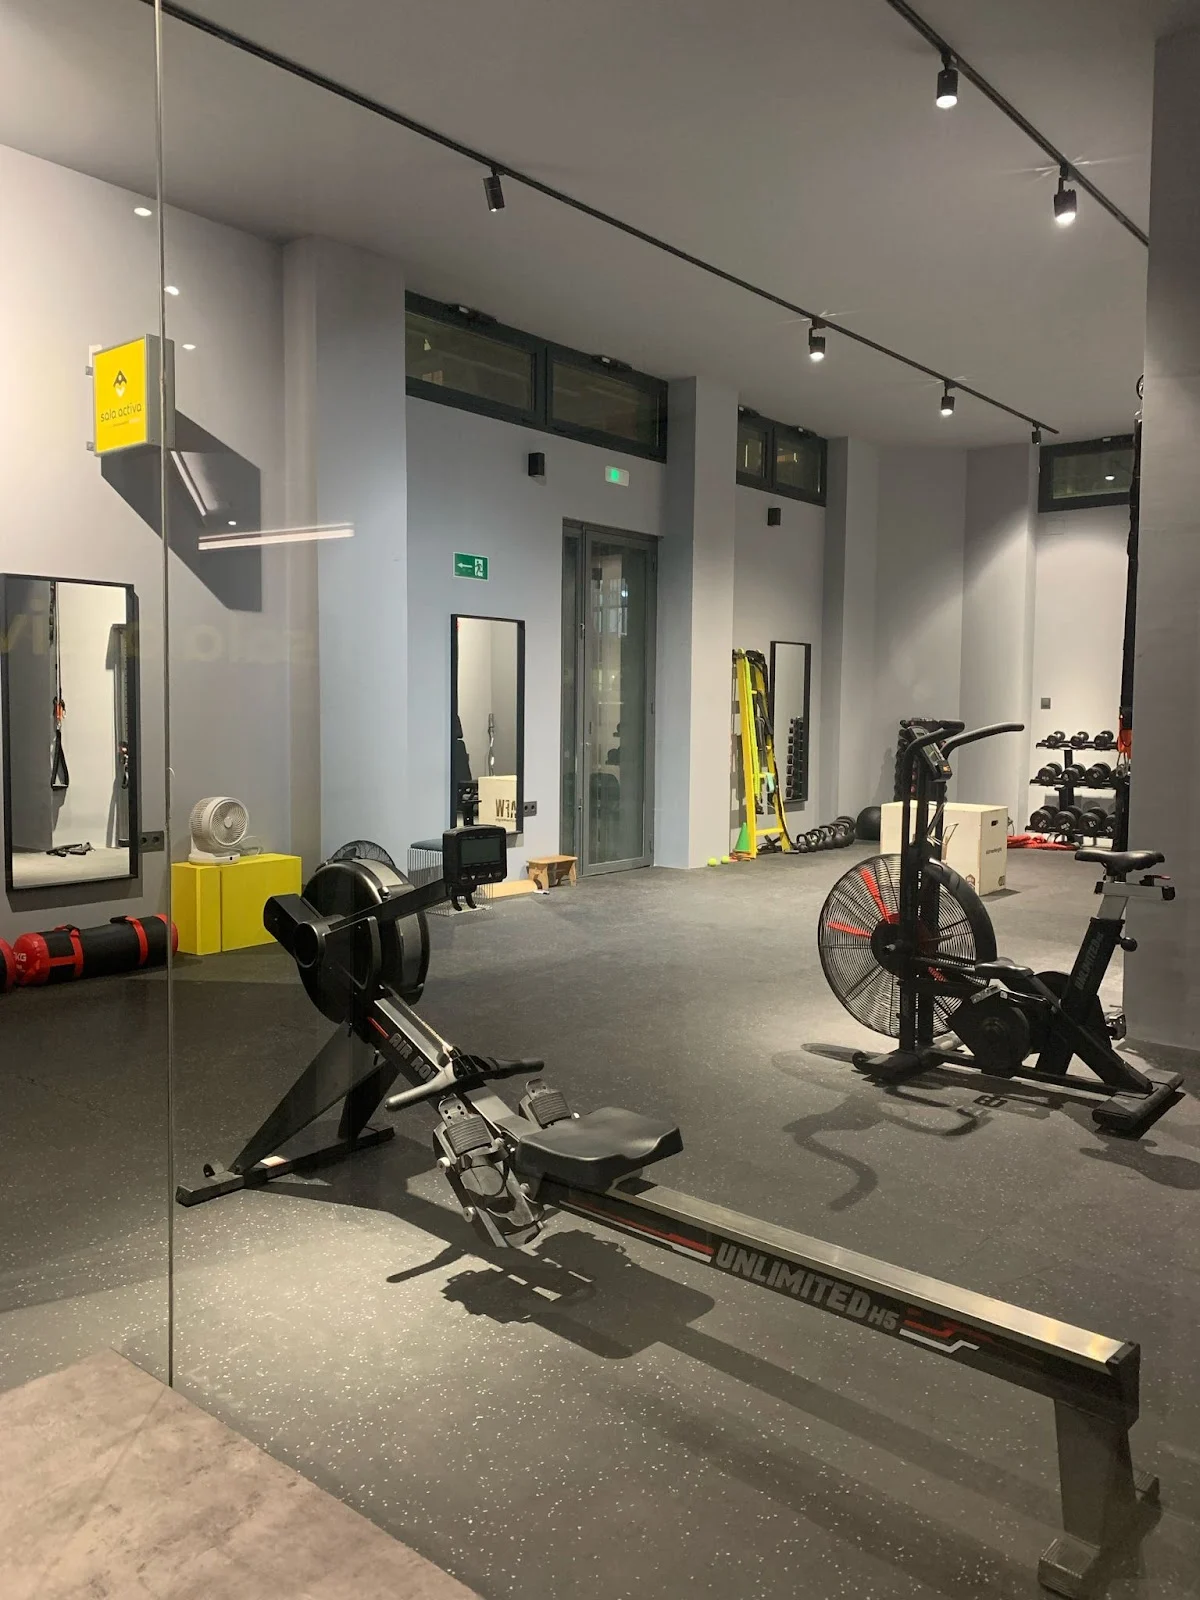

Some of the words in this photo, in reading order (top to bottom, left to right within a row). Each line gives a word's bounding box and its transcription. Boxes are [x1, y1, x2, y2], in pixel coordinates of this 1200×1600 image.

[100, 408, 116, 422] sala
[118, 402, 142, 417] activa
[388, 1032, 413, 1060] AIR
[715, 1242, 871, 1318] UNLIMITED
